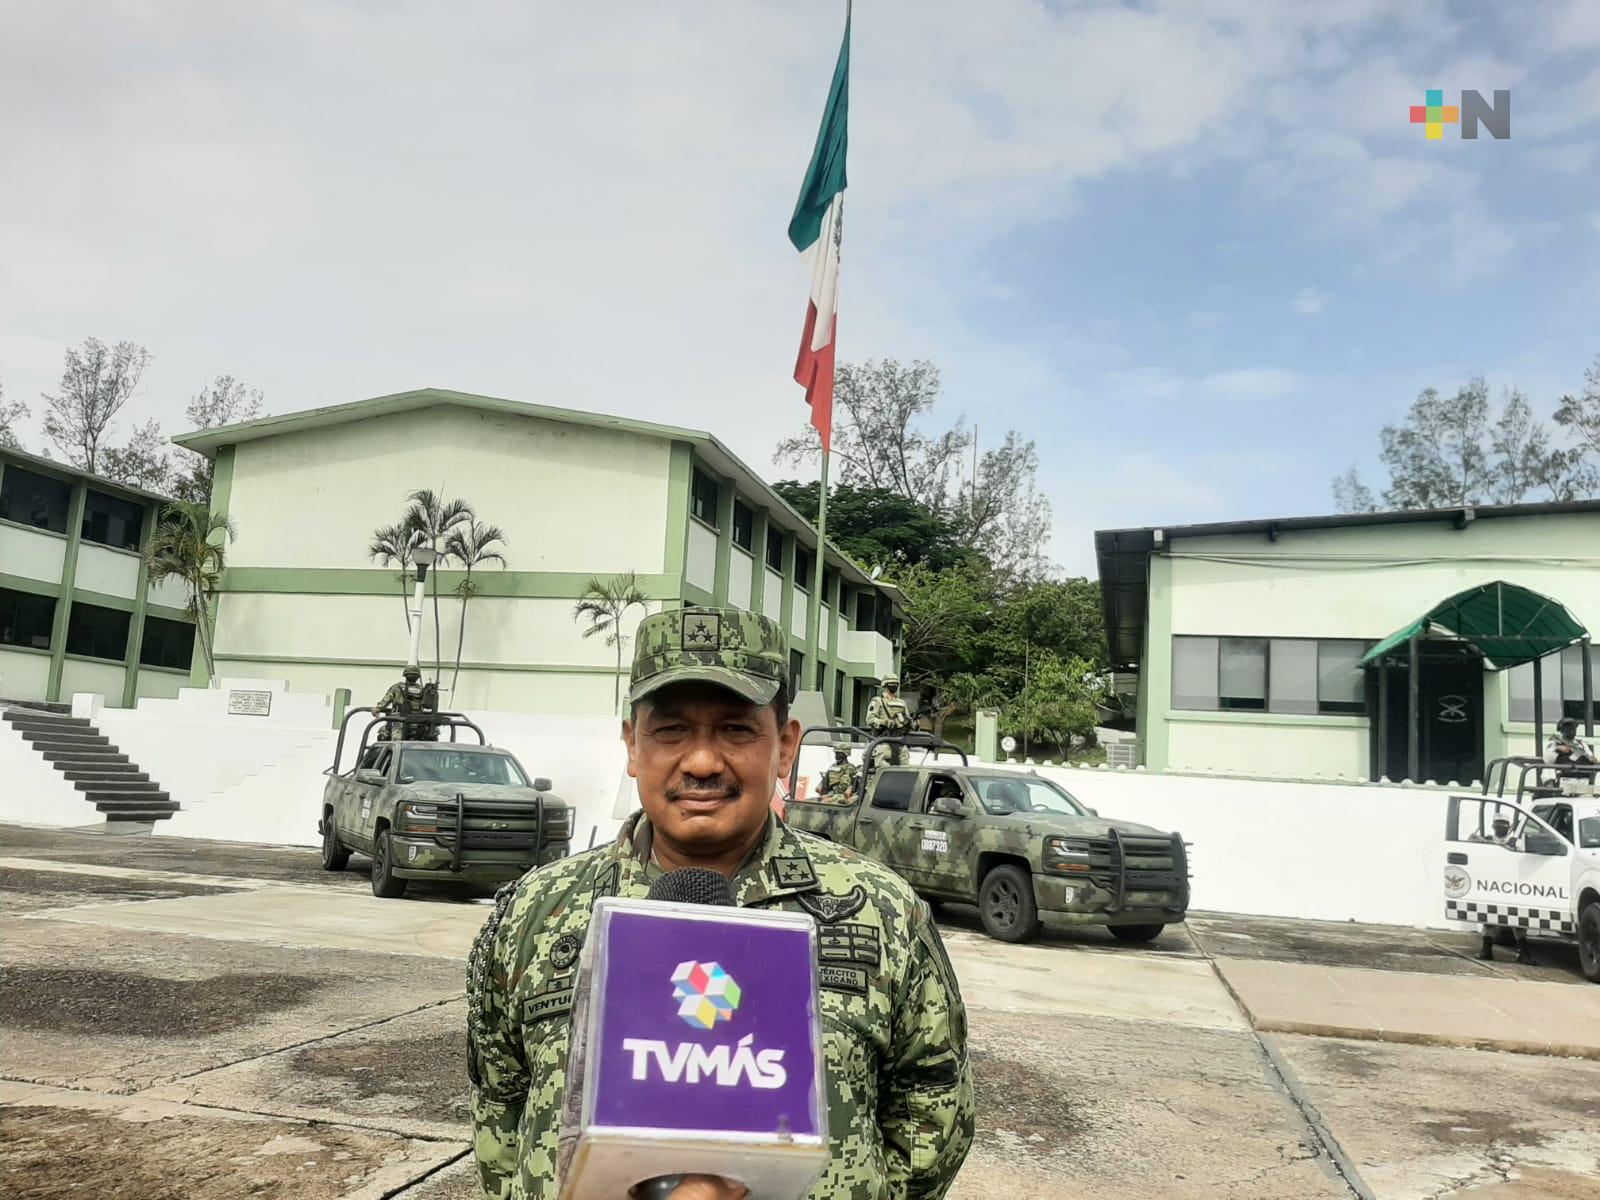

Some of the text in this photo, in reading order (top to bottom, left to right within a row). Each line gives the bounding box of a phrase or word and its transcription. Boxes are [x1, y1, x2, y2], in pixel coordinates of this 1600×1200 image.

[1476, 879, 1569, 900] NACIONAL
[819, 966, 857, 979] JÉRCITO
[822, 975, 859, 986] XICANO
[622, 1032, 788, 1090] TVMÁS
